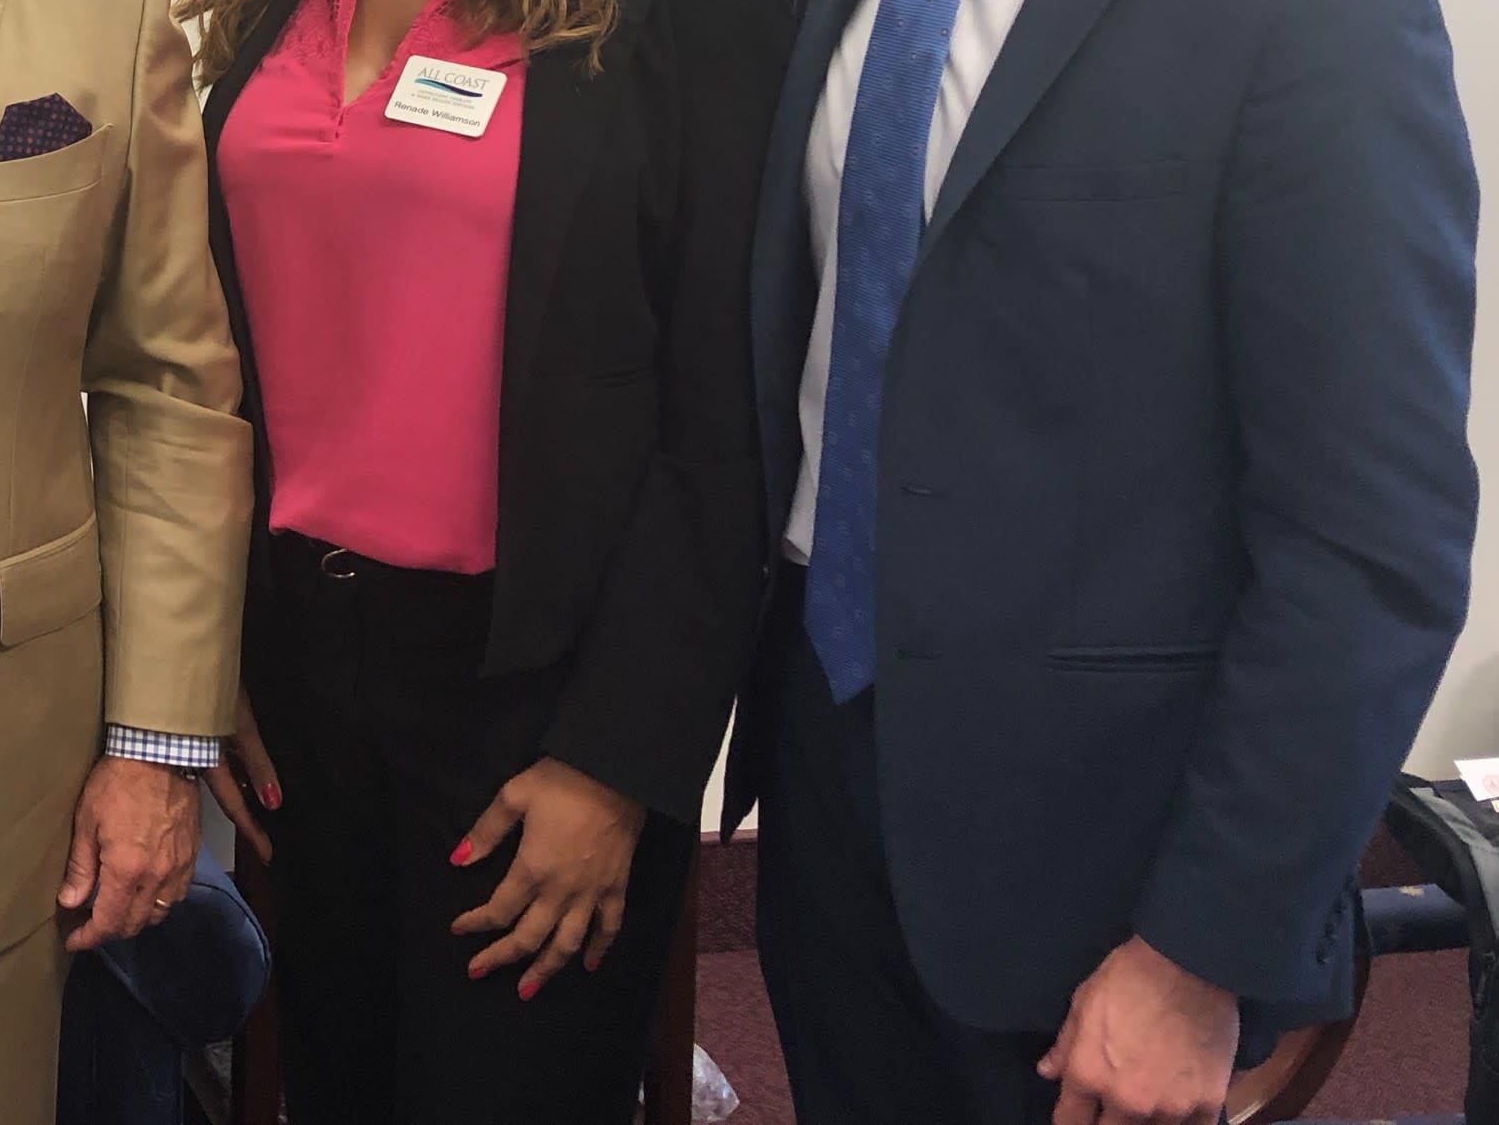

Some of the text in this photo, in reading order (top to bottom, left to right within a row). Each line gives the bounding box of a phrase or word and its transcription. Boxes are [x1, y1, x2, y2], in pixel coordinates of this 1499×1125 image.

[417, 67, 490, 90] ALL COAST
[432, 109, 481, 127] Williamson
